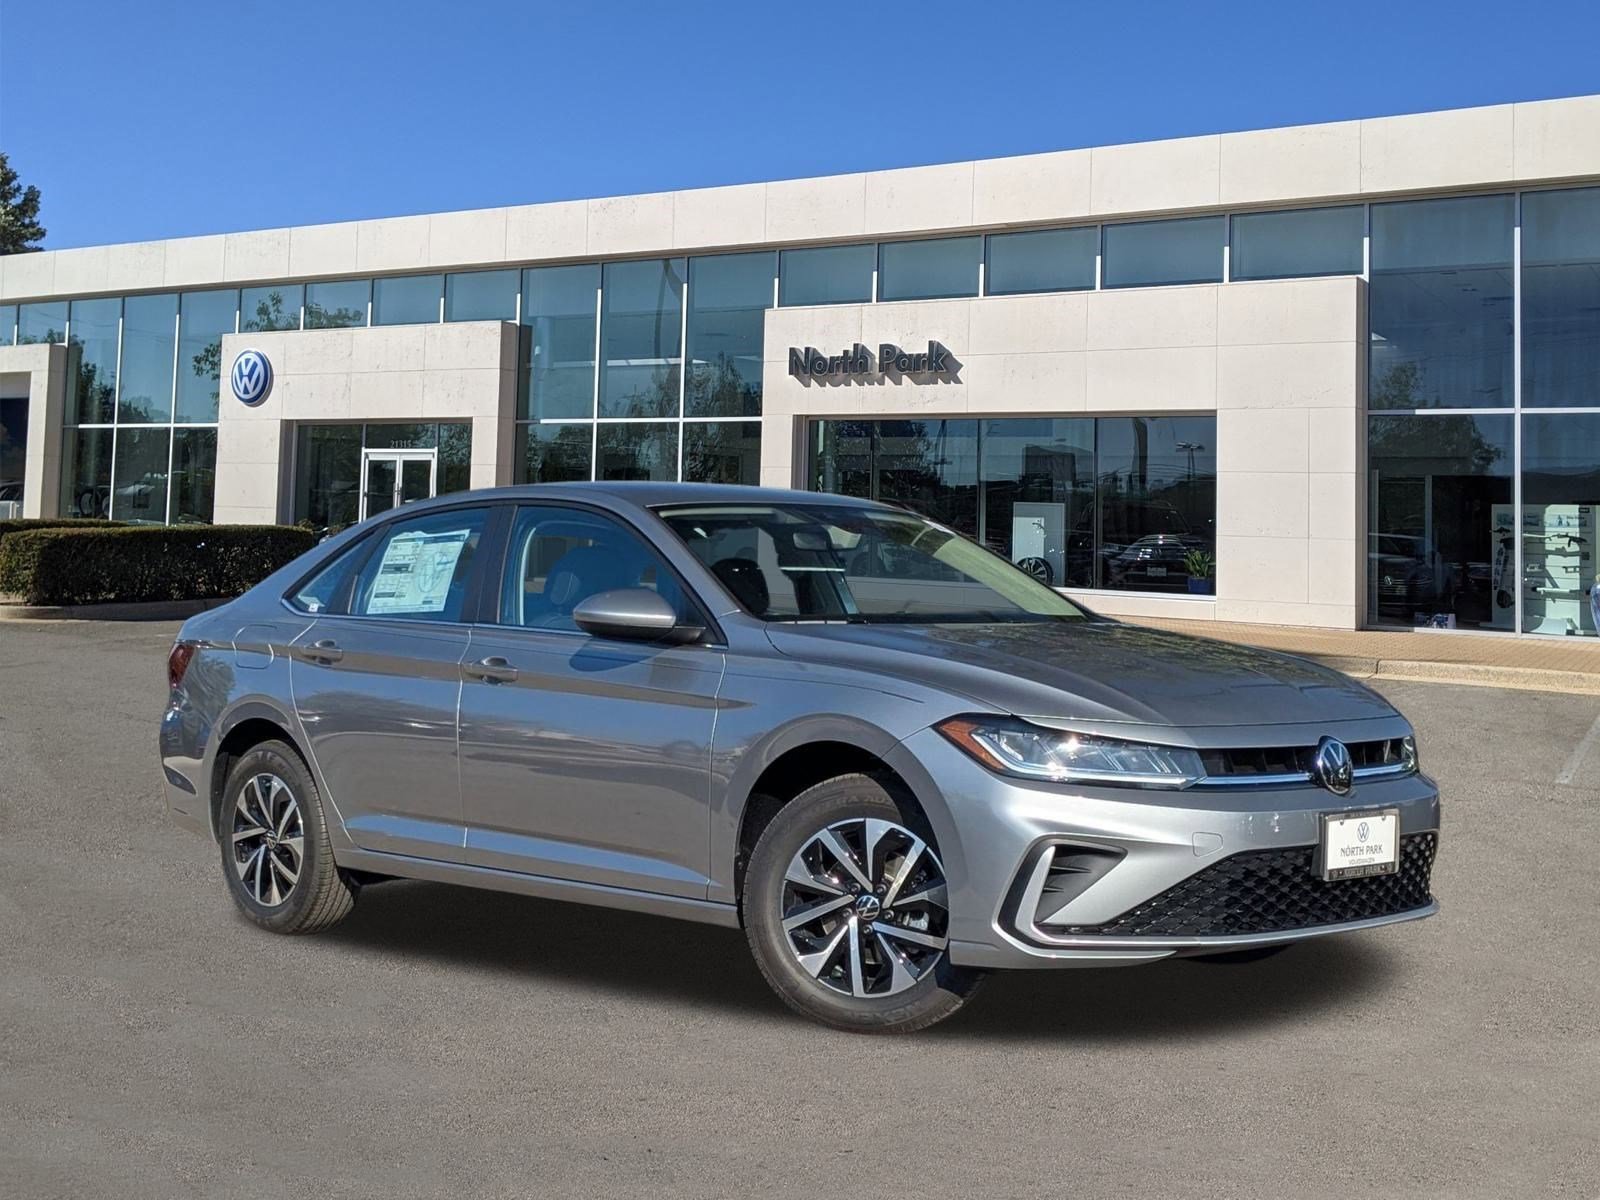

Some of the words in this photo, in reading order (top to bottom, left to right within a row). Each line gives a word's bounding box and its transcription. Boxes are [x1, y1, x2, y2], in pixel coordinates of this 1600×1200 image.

[788, 343, 870, 375] North
[878, 340, 947, 373] Park
[1340, 845, 1364, 857] NORTH
[1365, 844, 1383, 855] PARK
